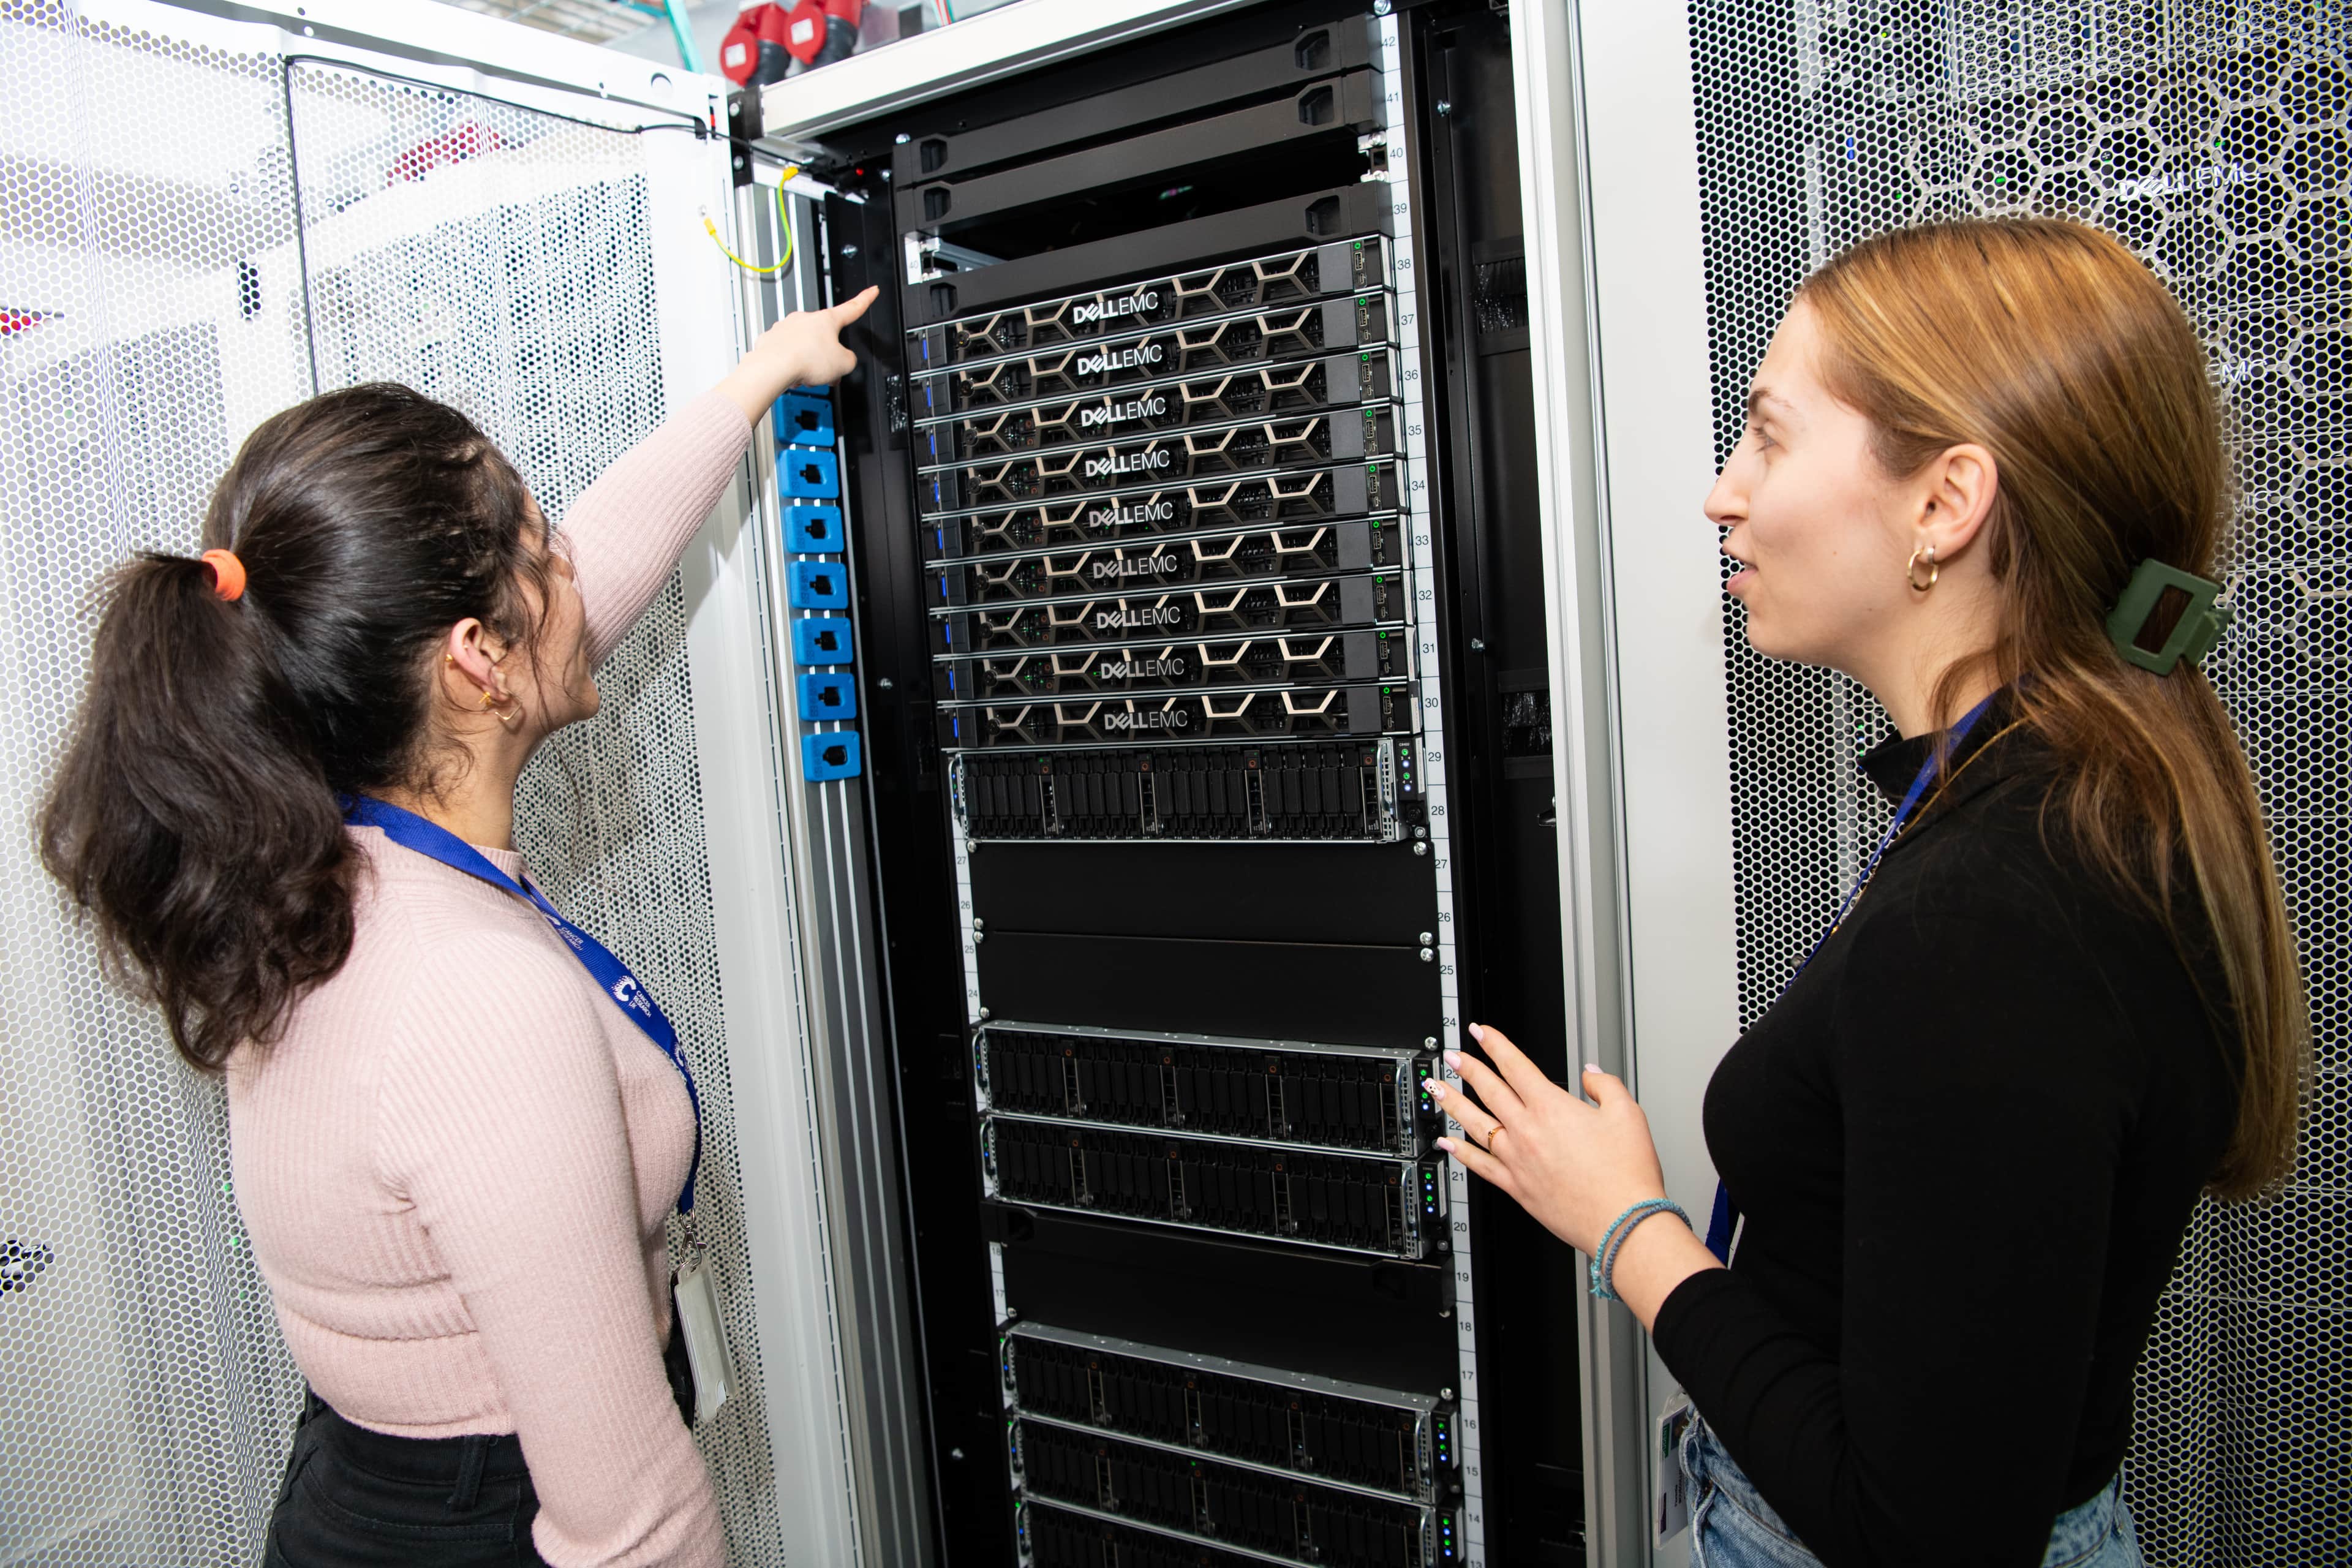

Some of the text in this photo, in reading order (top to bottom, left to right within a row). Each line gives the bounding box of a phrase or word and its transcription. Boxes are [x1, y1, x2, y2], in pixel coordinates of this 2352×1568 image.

[1382, 37, 1396, 47] 42
[1387, 92, 1399, 103] 41
[1390, 148, 1403, 158] 40
[1393, 203, 1407, 215] 39
[1397, 259, 1411, 270] 38
[1401, 314, 1414, 325] 37
[1404, 370, 1419, 380] 36
[1408, 425, 1422, 435] 35
[1411, 480, 1425, 491] 34
[1415, 536, 1429, 546] 33
[1419, 590, 1432, 600] 32
[1422, 644, 1435, 654] 31
[1425, 698, 1438, 708] 30
[1428, 752, 1441, 762] 29
[1431, 806, 1445, 816] 28
[957, 856, 967, 865] 27
[1434, 859, 1447, 869] 27
[960, 900, 971, 910] 26
[1438, 913, 1450, 922] 26
[560, 927, 584, 944] CANCER
[965, 945, 974, 954] 25
[1440, 965, 1453, 975] 25
[968, 989, 978, 998] 24
[628, 1000, 638, 1010] UK
[633, 995, 652, 1018] RESEARCH
[1443, 1017, 1456, 1027] 24
[1446, 1069, 1459, 1079] 23
[1449, 1121, 1462, 1131] 22
[1452, 1172, 1464, 1182] 21
[1453, 1223, 1467, 1232] 20
[992, 1246, 1001, 1256] 18
[1457, 1273, 1469, 1282] 19
[995, 1288, 1005, 1297] 17
[1460, 1322, 1472, 1332] 18
[1462, 1371, 1474, 1380] 17
[1464, 1419, 1477, 1430] 16
[1466, 1466, 1479, 1477] 15
[1469, 1513, 1480, 1524] 14
